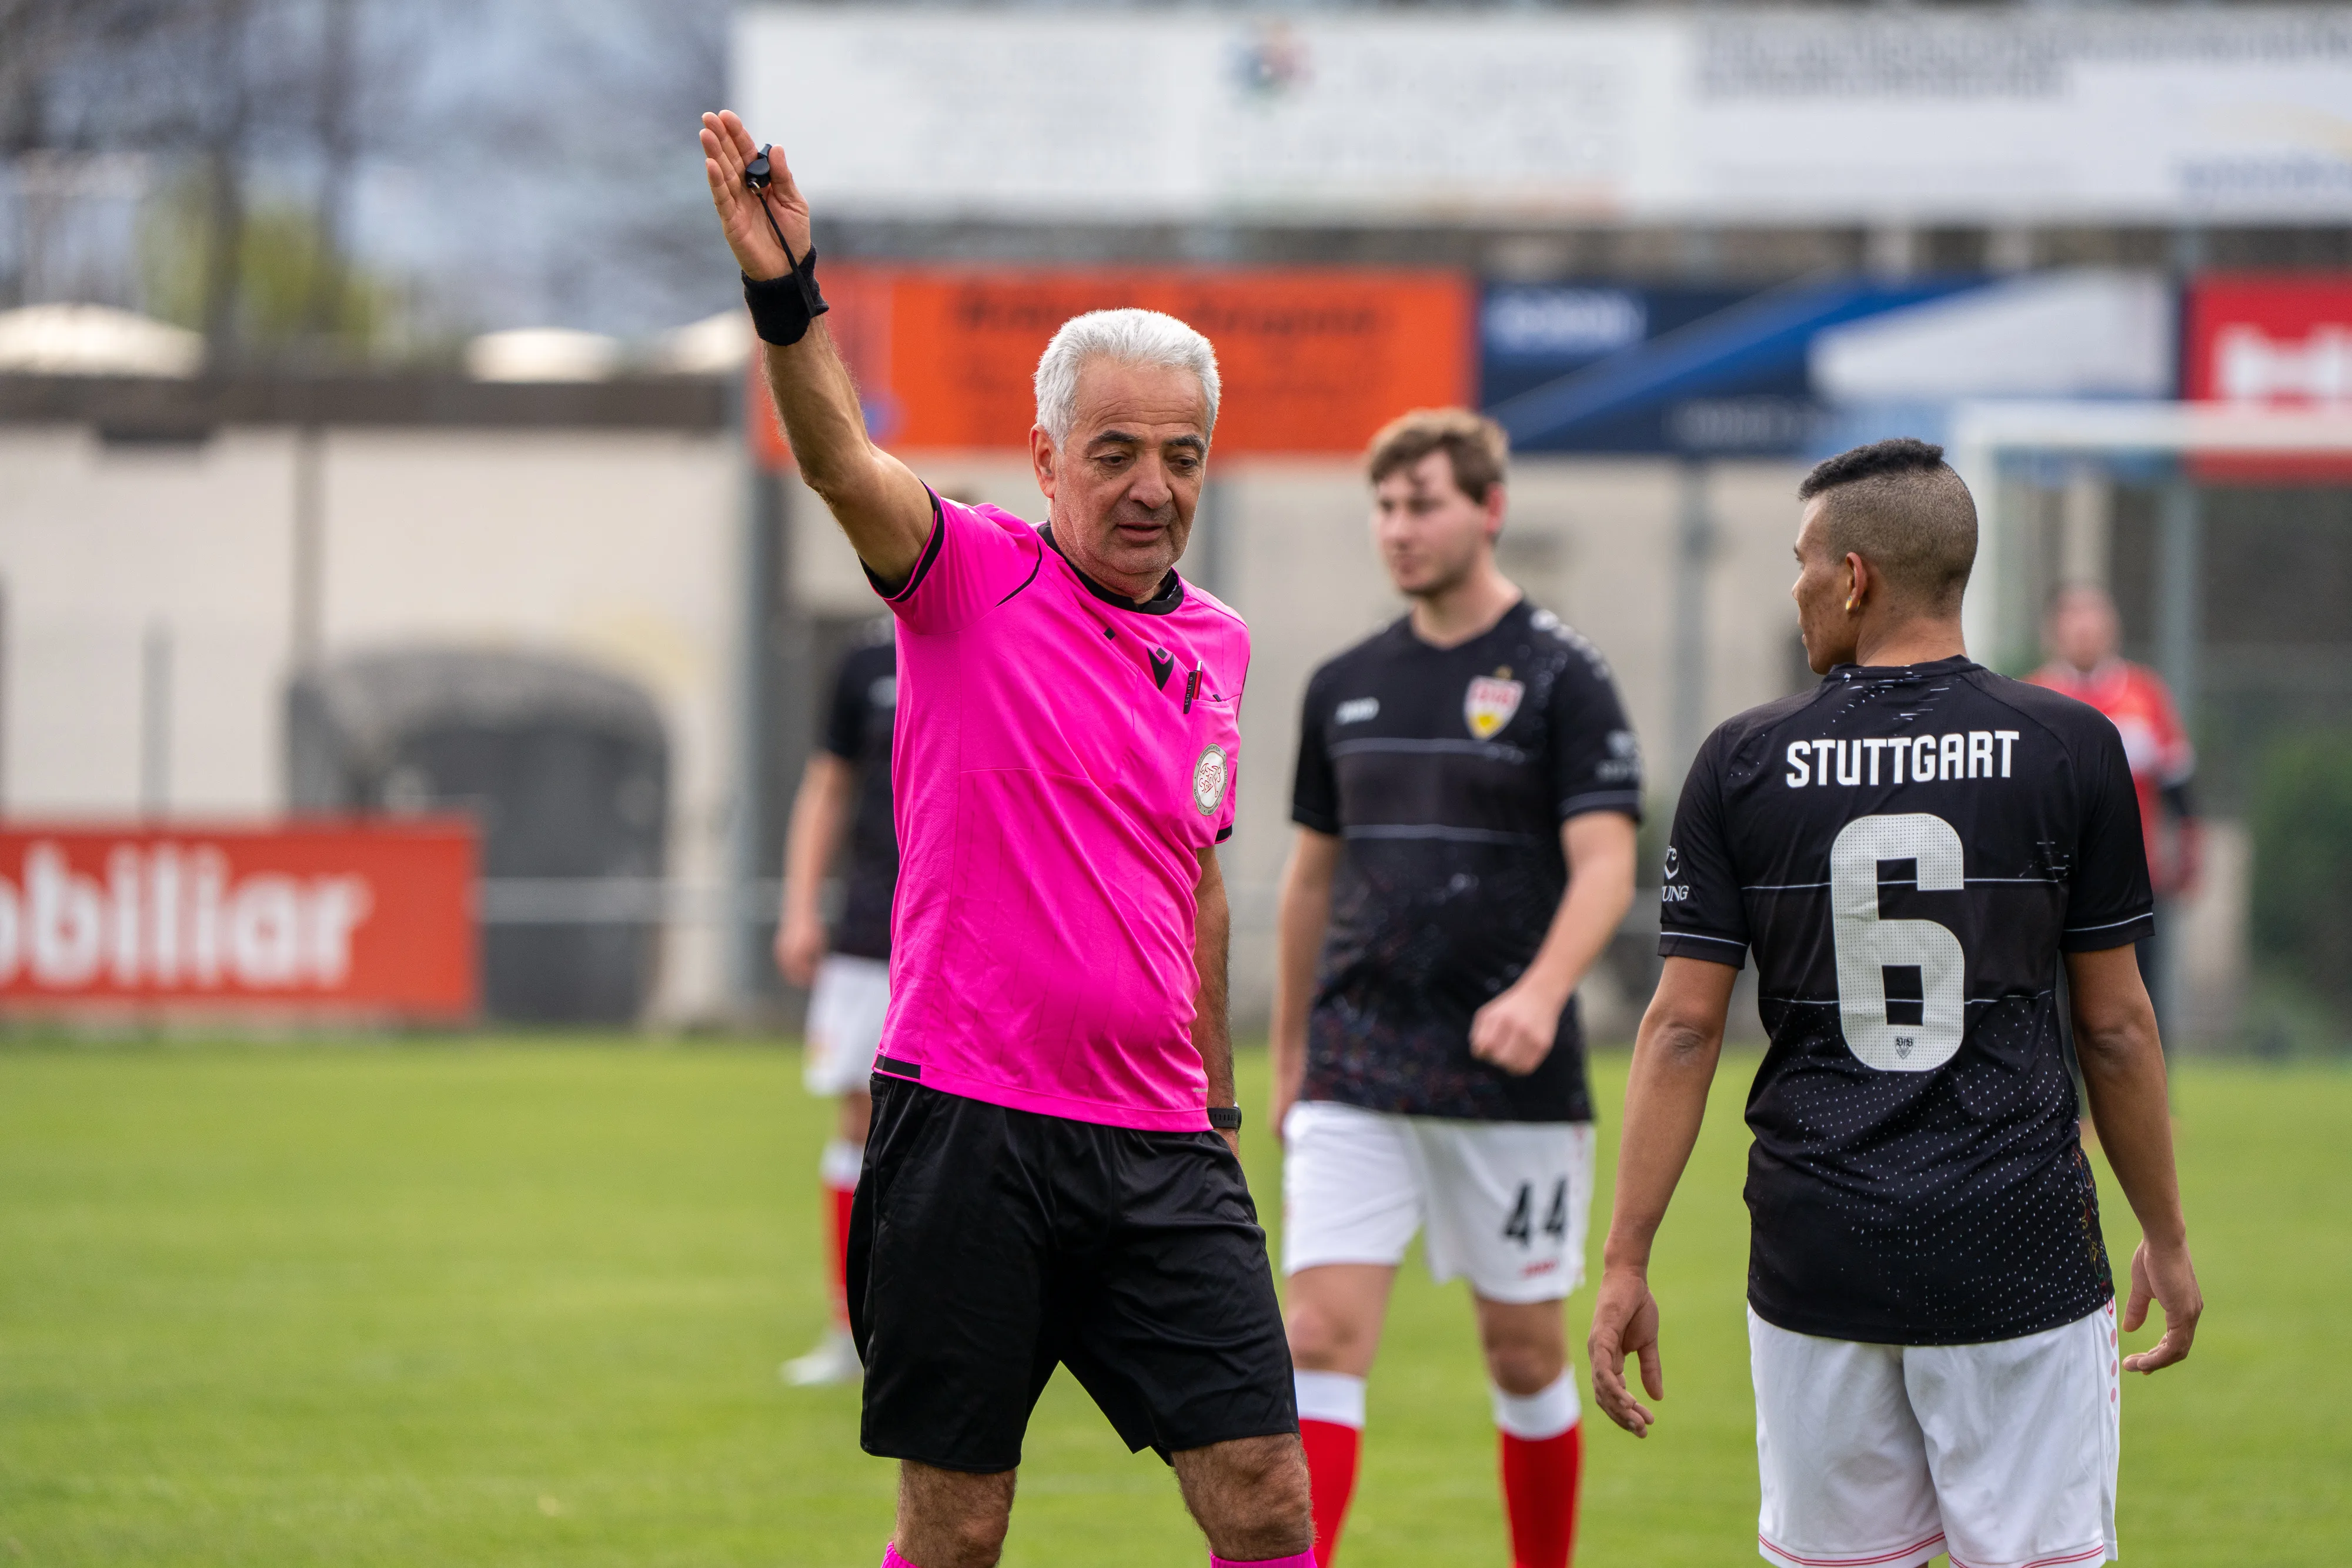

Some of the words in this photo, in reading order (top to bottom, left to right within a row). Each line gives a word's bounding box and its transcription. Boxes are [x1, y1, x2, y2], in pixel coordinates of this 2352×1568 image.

[1786, 731, 2019, 788] STUTTGART
[1831, 813, 1965, 1072] 6
[1501, 1177, 1569, 1250] 44
